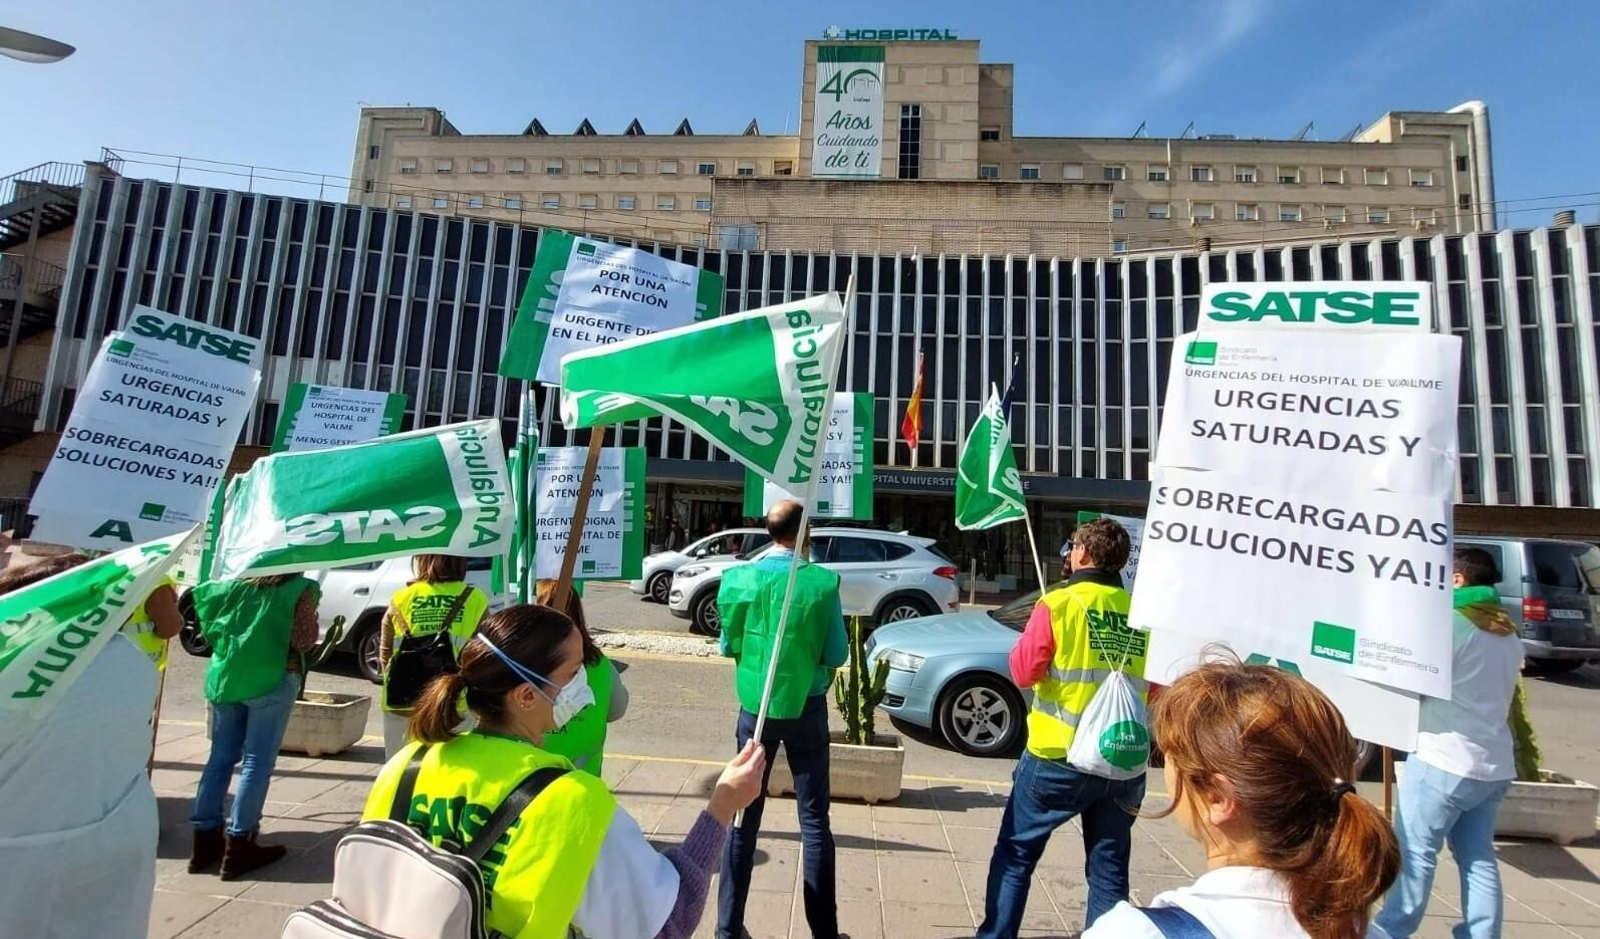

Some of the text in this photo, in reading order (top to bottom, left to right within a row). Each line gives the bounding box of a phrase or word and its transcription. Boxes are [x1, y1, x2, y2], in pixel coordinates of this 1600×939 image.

[845, 28, 957, 40] HOSPITAL
[825, 110, 872, 130] Años
[817, 134, 879, 147] Cuidando
[825, 149, 869, 168] de ti
[599, 269, 667, 292] POR UNA
[591, 284, 668, 309] ATENCIÓN
[1207, 291, 1420, 325] SATSE
[565, 314, 632, 334] URGENTE
[131, 314, 255, 364] SATSE
[552, 327, 572, 339] EN
[576, 331, 591, 342] EL
[107, 356, 154, 373] URGENCIAS
[155, 368, 169, 378] DEL
[171, 372, 208, 388] HOSPITAL
[1185, 368, 1444, 391] URGENCIAS DEL HOSPITAL DE VALME
[121, 372, 224, 408] URGENCIAS
[99, 390, 227, 428] SATURADAS Y
[311, 402, 359, 413] URGENCIAS
[1214, 389, 1403, 419] URGENCIAS
[313, 412, 353, 422] HOSPITAL
[323, 422, 354, 431] VALME
[295, 436, 328, 445] MENOS
[1191, 419, 1421, 457] SATURADAS Y
[65, 427, 226, 470] SOBRECARGADAS
[56, 447, 219, 489] SOLUCIONES YA!!
[551, 474, 574, 483] POR
[830, 475, 851, 484] YA!!
[873, 474, 956, 486] PITAL UNIVERSIT
[1155, 486, 1448, 546] SOBRECARGADAS
[541, 532, 552, 540] EL
[607, 530, 621, 539] DE
[1148, 520, 1446, 590] SOLUCIONES YA!!
[412, 595, 463, 609] SATS
[1313, 645, 1352, 660] SATSE
[1359, 638, 1412, 656] Sindicato
[1358, 650, 1439, 674] de Enfermería
